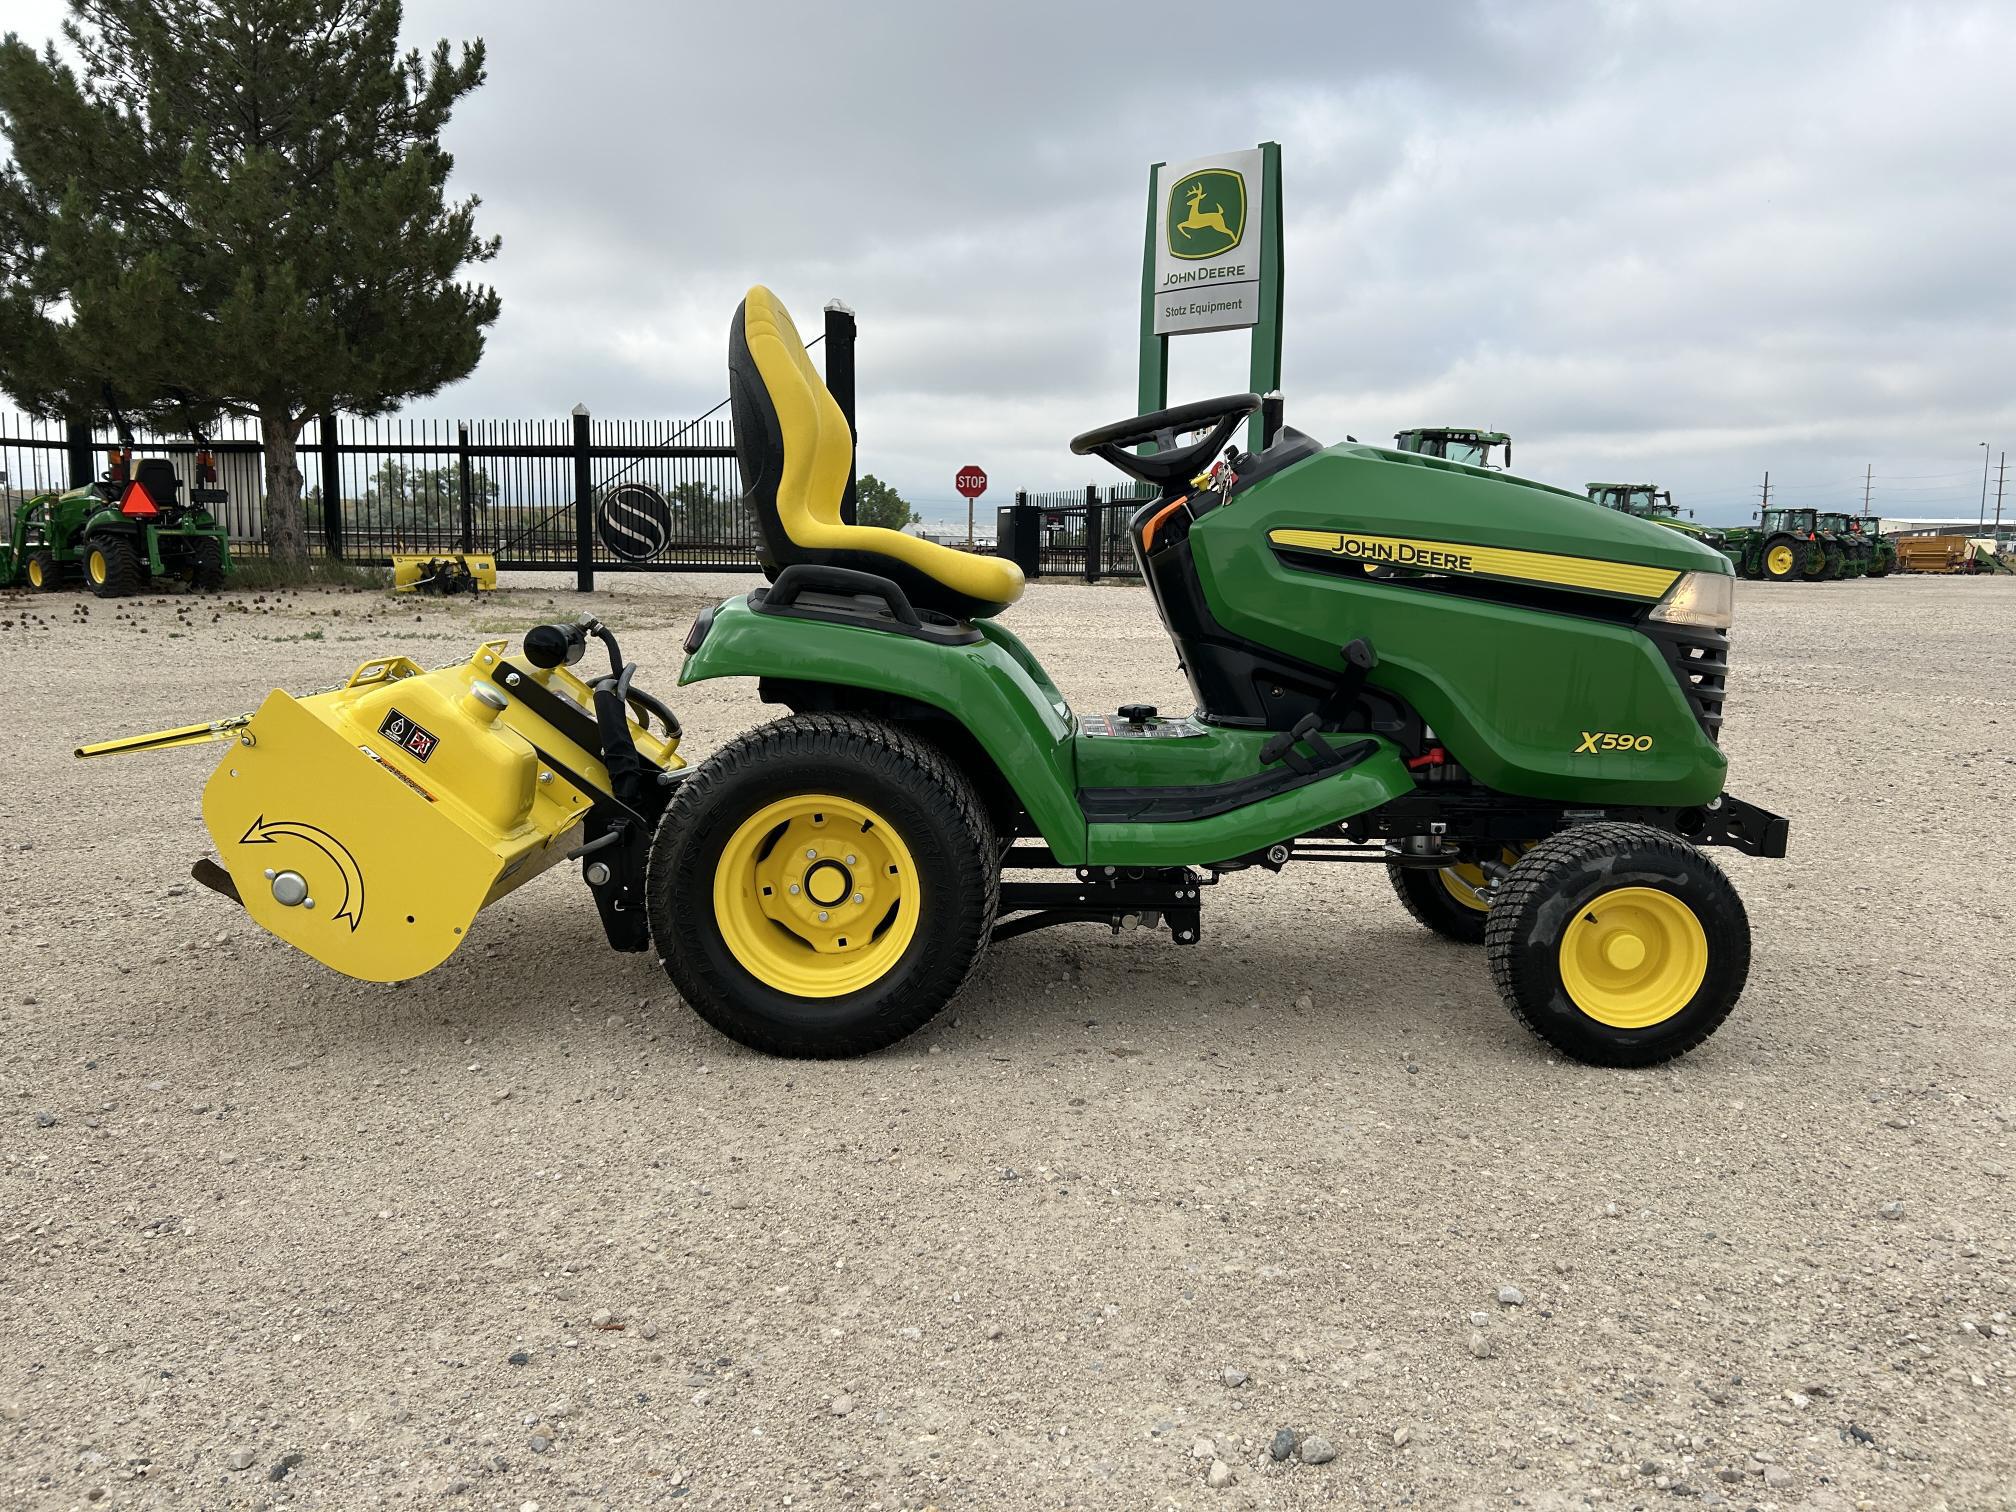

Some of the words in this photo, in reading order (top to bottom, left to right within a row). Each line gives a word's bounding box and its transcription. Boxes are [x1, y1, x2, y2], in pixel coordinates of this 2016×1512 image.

[1163, 271, 1196, 286] JOHN
[1198, 265, 1246, 281] DEERE
[1165, 305, 1187, 318] Stotz
[1189, 298, 1243, 315] Equipment
[957, 475, 986, 488] STOP
[1331, 535, 1393, 560] JOHN
[1398, 543, 1474, 572] DEERE
[1573, 731, 1653, 754] X590
